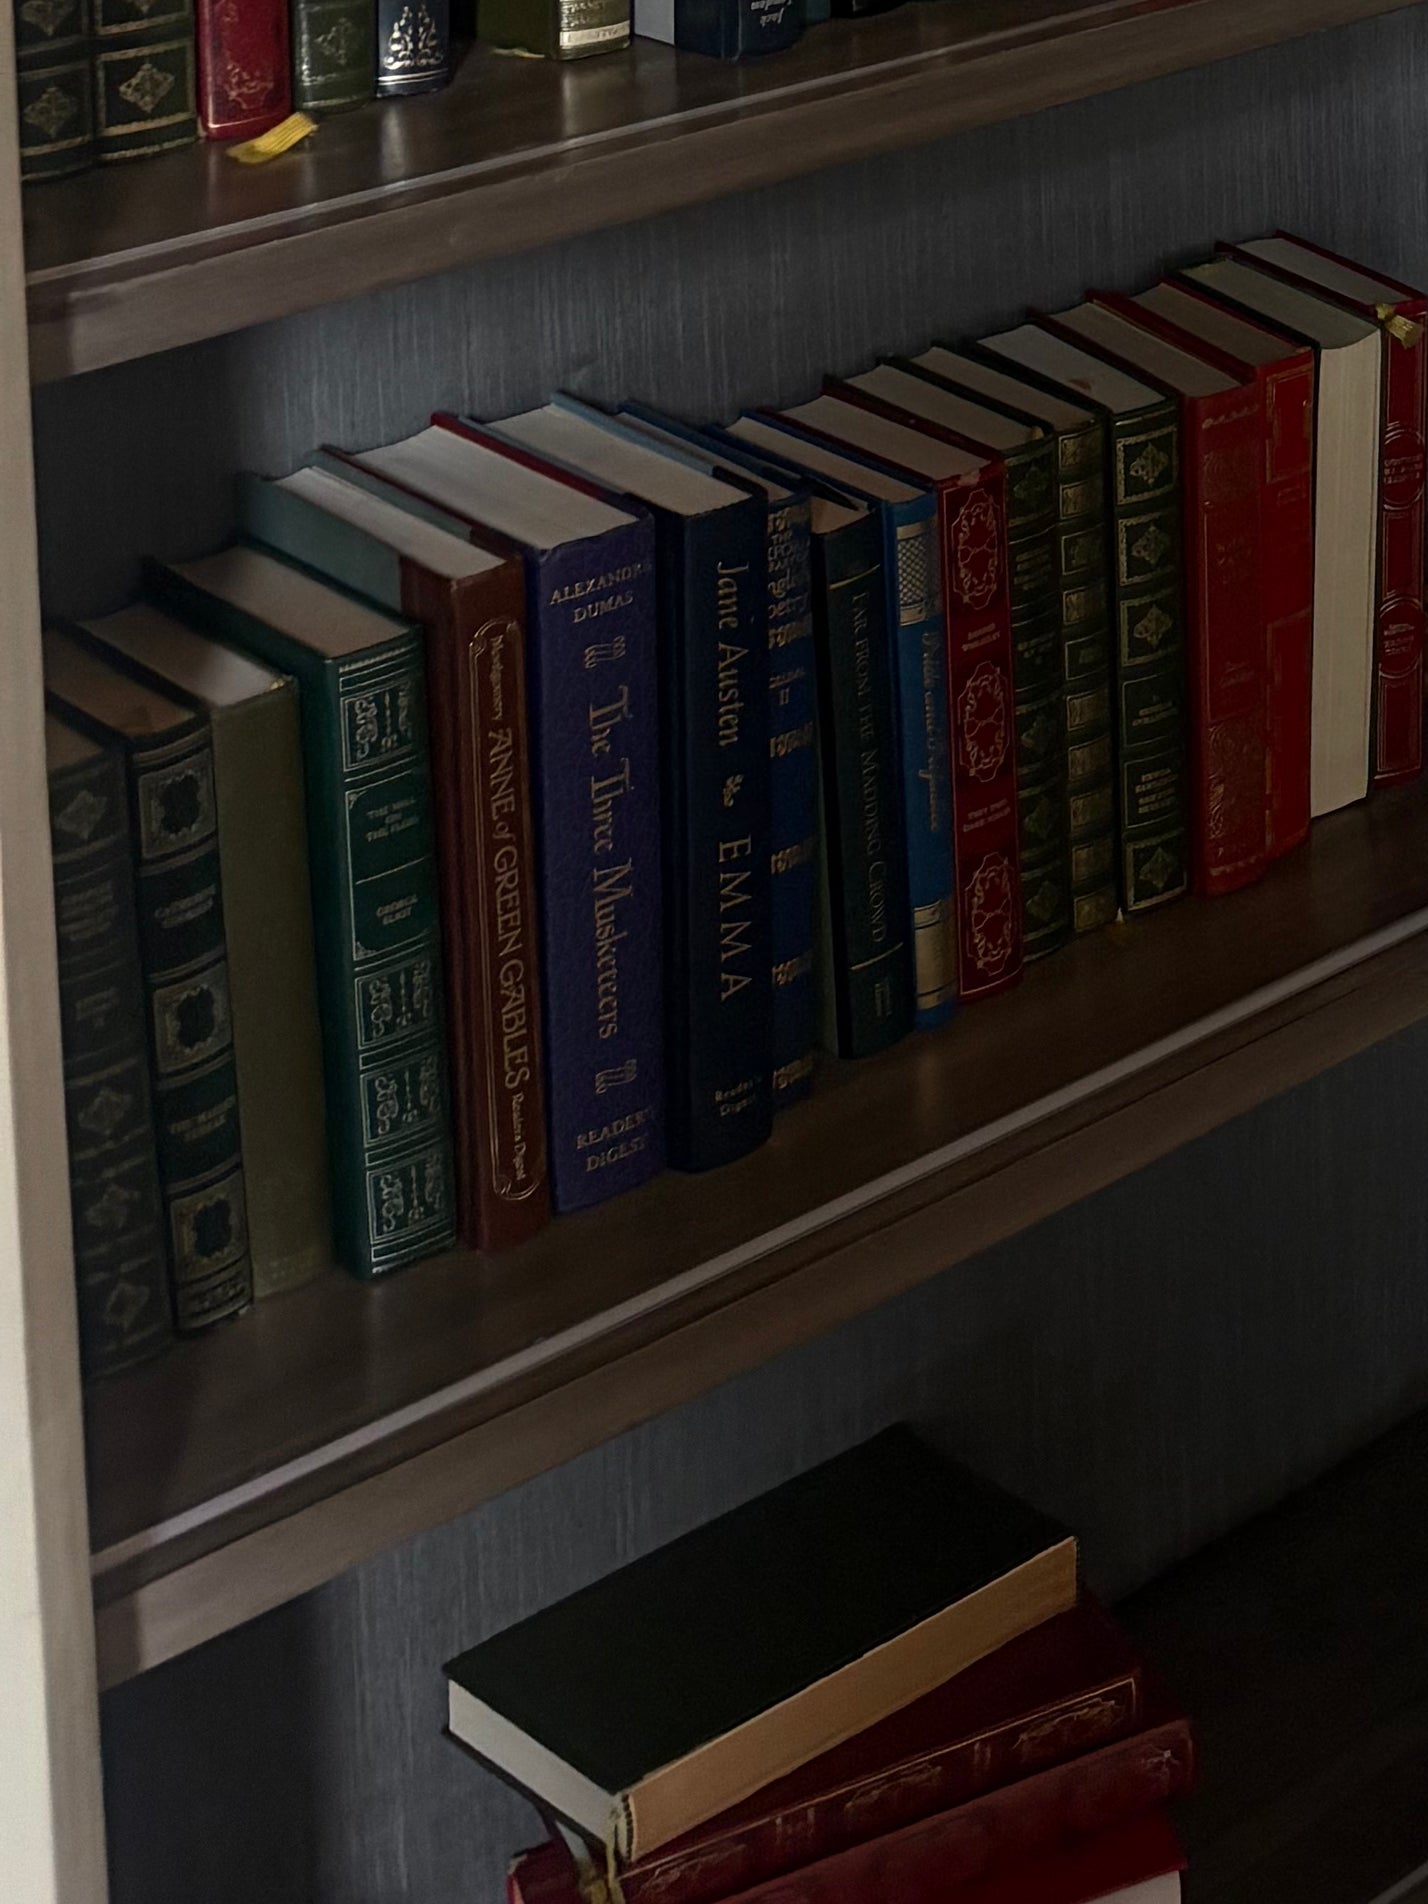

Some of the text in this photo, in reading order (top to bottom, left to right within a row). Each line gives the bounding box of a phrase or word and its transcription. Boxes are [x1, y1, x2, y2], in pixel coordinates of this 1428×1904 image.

[572, 591, 634, 626] DUMAS
[855, 638, 873, 696] FROM
[717, 561, 753, 1002] Jane Austen EMMA
[860, 748, 886, 858] MADDING
[488, 727, 531, 1090] ANNE of GREEN GABLES
[588, 684, 635, 1041] The Three Musketeers
[867, 861, 889, 944] CROWD
[585, 1130, 649, 1173] DIGEST
